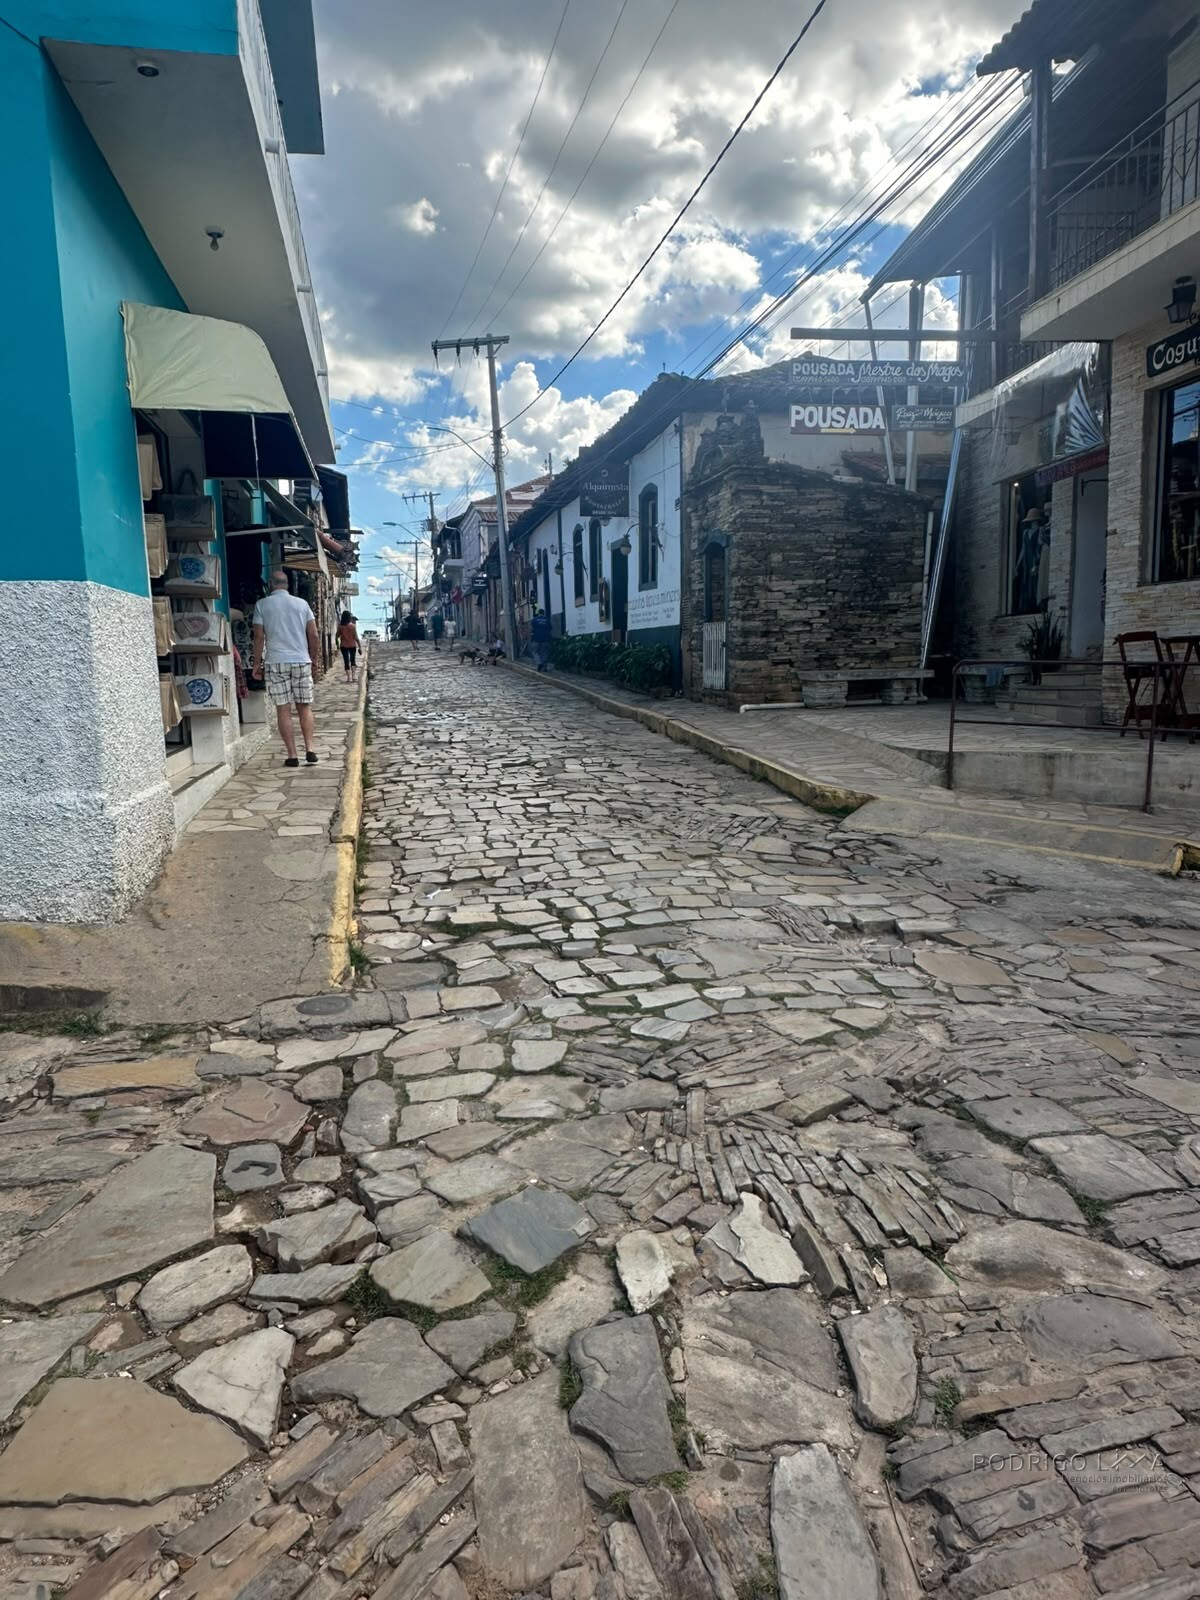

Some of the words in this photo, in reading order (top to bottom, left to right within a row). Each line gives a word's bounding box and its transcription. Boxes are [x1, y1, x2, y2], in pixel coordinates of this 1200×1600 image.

[1153, 336, 1200, 370] Cogu
[792, 362, 855, 375] POUSADA
[851, 362, 903, 383] Mestre
[906, 361, 926, 376] dos
[917, 362, 963, 382] Magos
[791, 405, 886, 430] POUSADA
[582, 481, 629, 493] Alquimista
